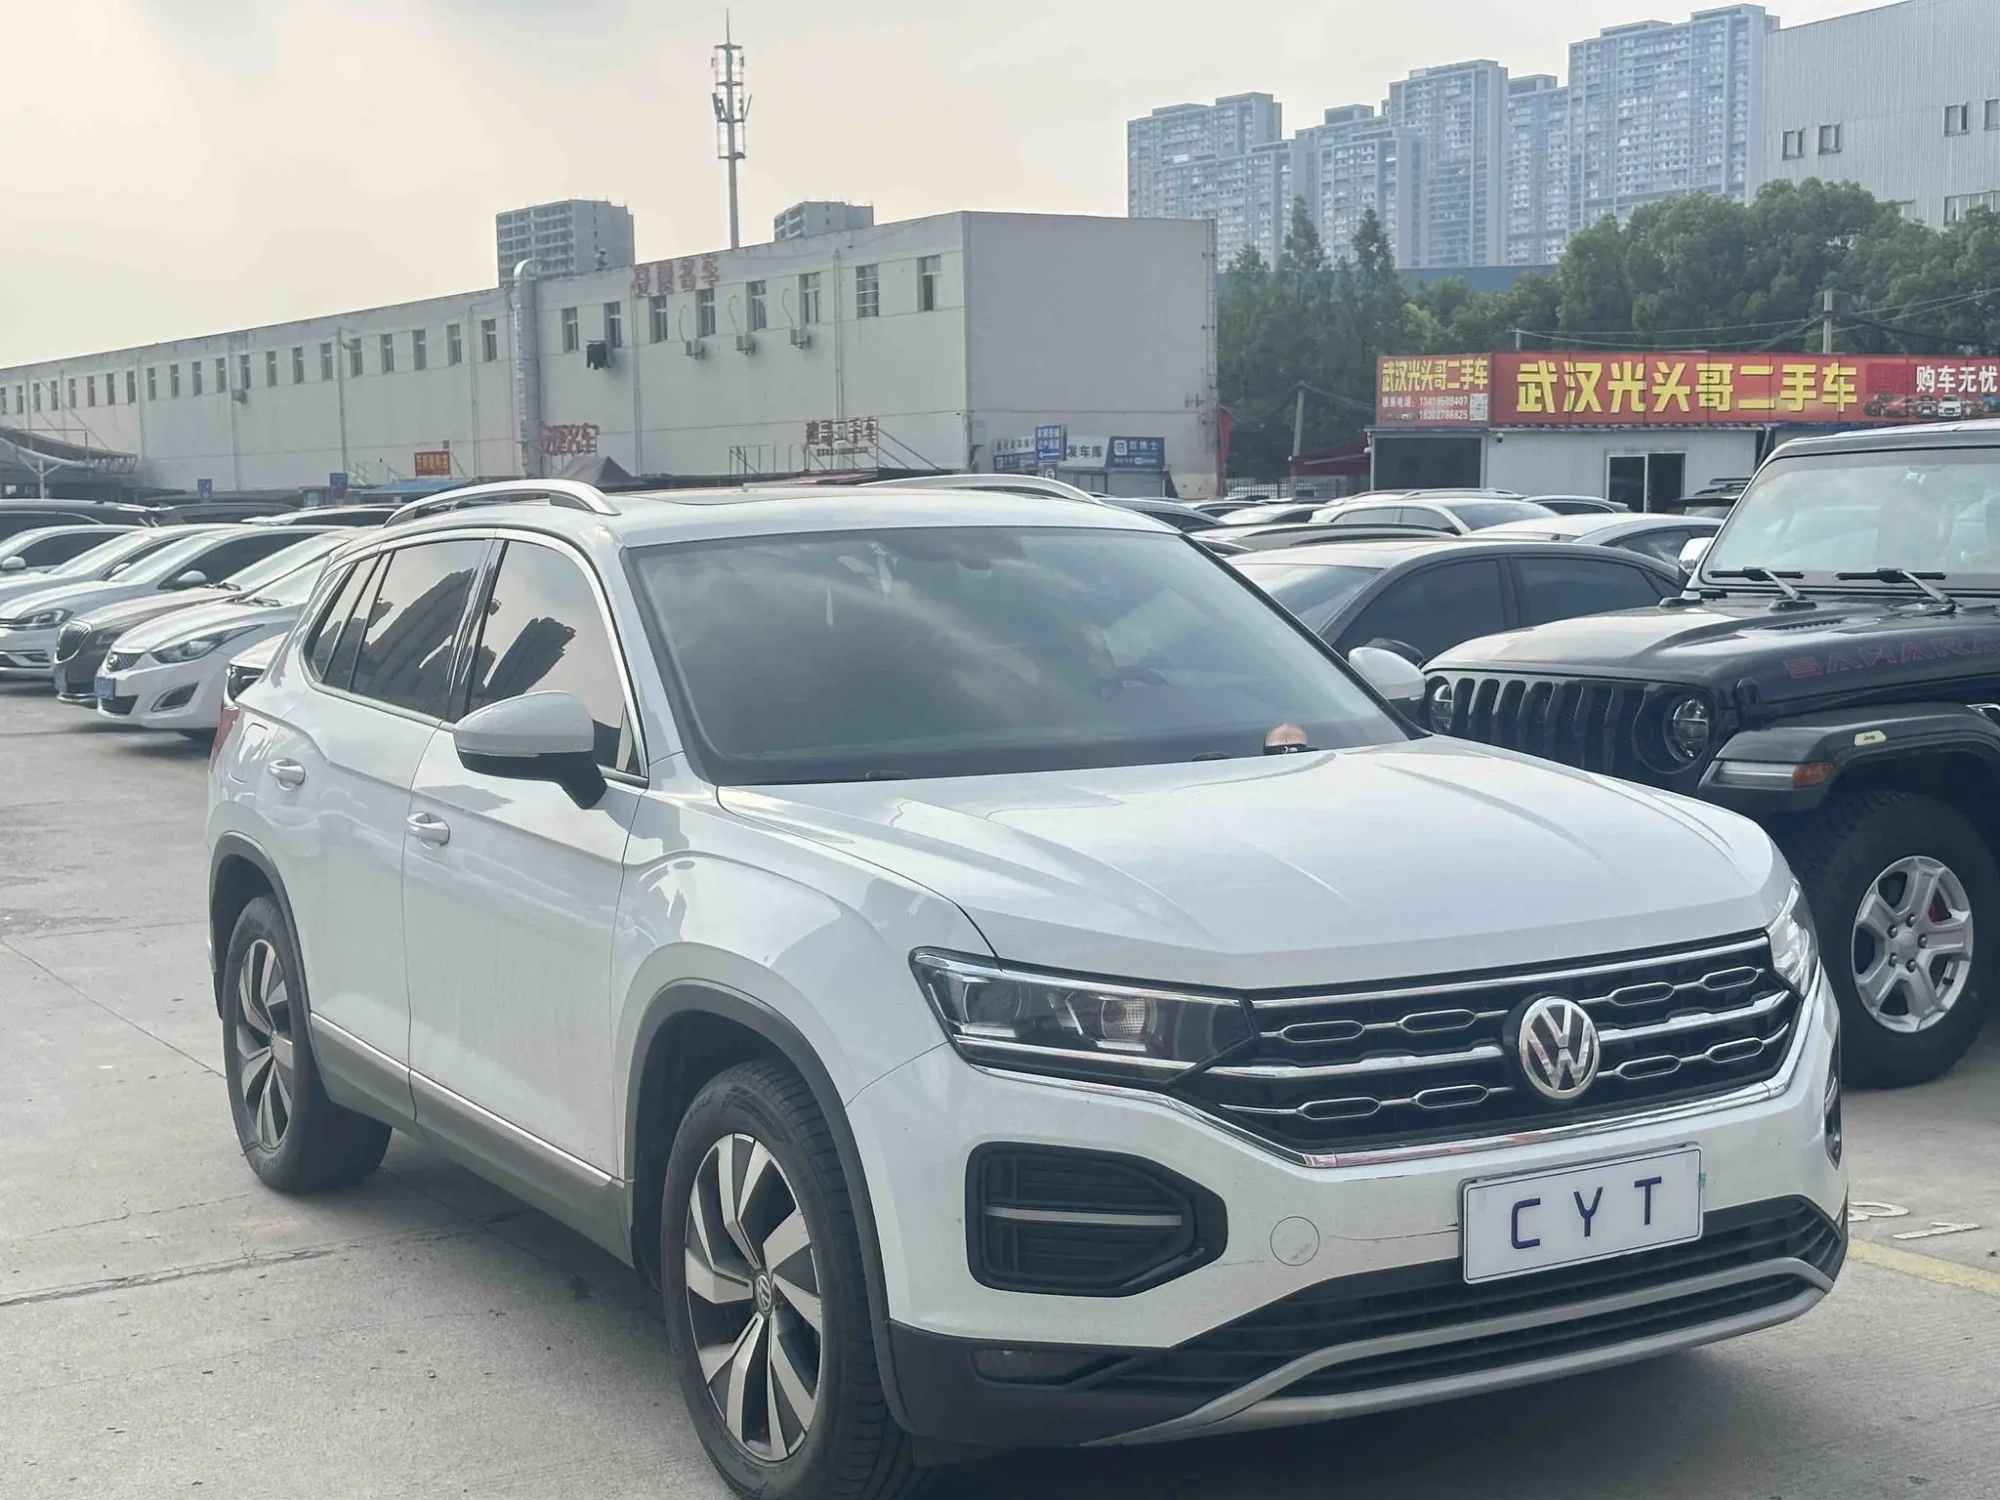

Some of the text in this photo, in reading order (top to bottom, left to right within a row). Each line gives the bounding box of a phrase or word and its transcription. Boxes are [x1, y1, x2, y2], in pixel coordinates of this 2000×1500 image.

[1382, 357, 1488, 392] 武汉光头哥二手车
[1516, 361, 1858, 414] 武汉光头哥二手车
[1916, 365, 1998, 393] 购车无忧
